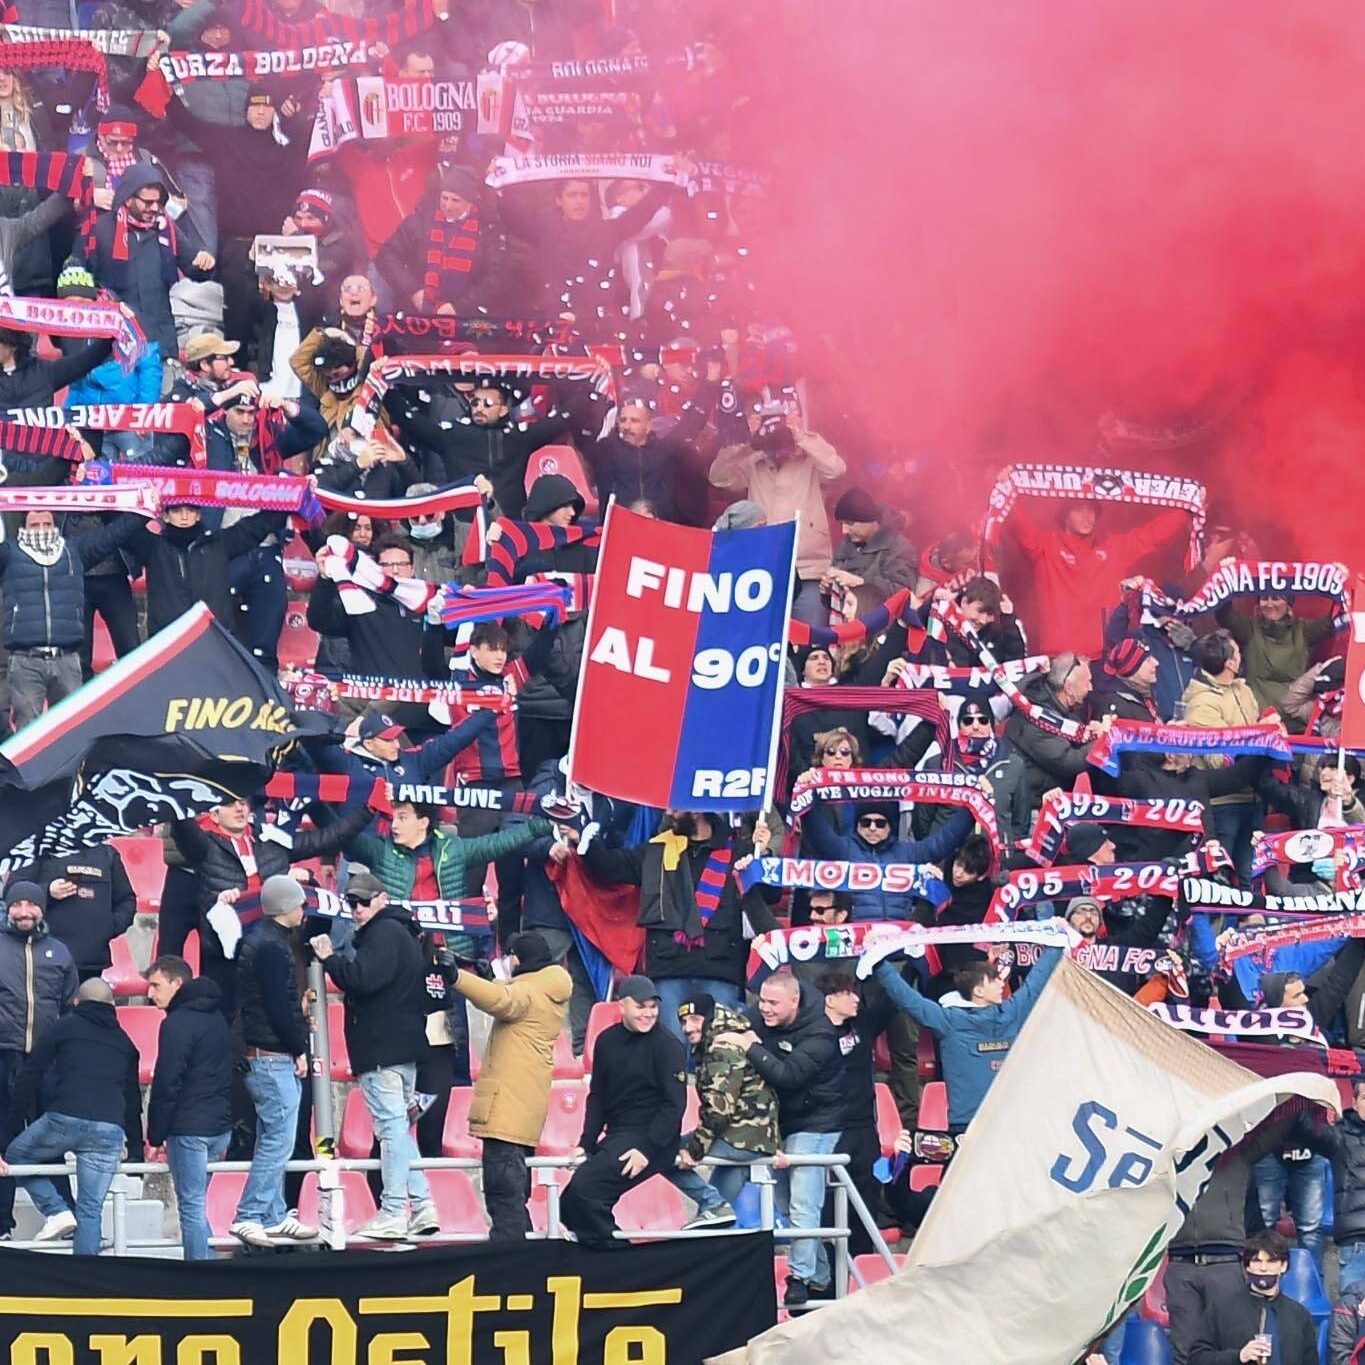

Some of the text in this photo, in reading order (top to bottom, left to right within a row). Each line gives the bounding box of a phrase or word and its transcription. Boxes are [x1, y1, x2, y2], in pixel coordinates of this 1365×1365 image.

[161, 50, 242, 84] FORZA
[385, 83, 476, 111] BOLOGNA
[432, 112, 462, 132] 1909
[535, 156, 580, 171] STORIA
[7, 405, 172, 427] ONE ARE WE
[627, 555, 774, 613] FINO
[1256, 563, 1345, 594] FC 1909
[590, 627, 670, 683] AL
[164, 700, 250, 733] FINO
[828, 771, 909, 785] TE SONO
[398, 784, 502, 808] ARE ONE
[791, 785, 913, 812] CON TE VOGLIO
[784, 859, 915, 892] MODS
[1182, 878, 1255, 908] ODIO
[1123, 948, 1157, 974] FC
[1282, 1146, 1312, 1161] FILA
